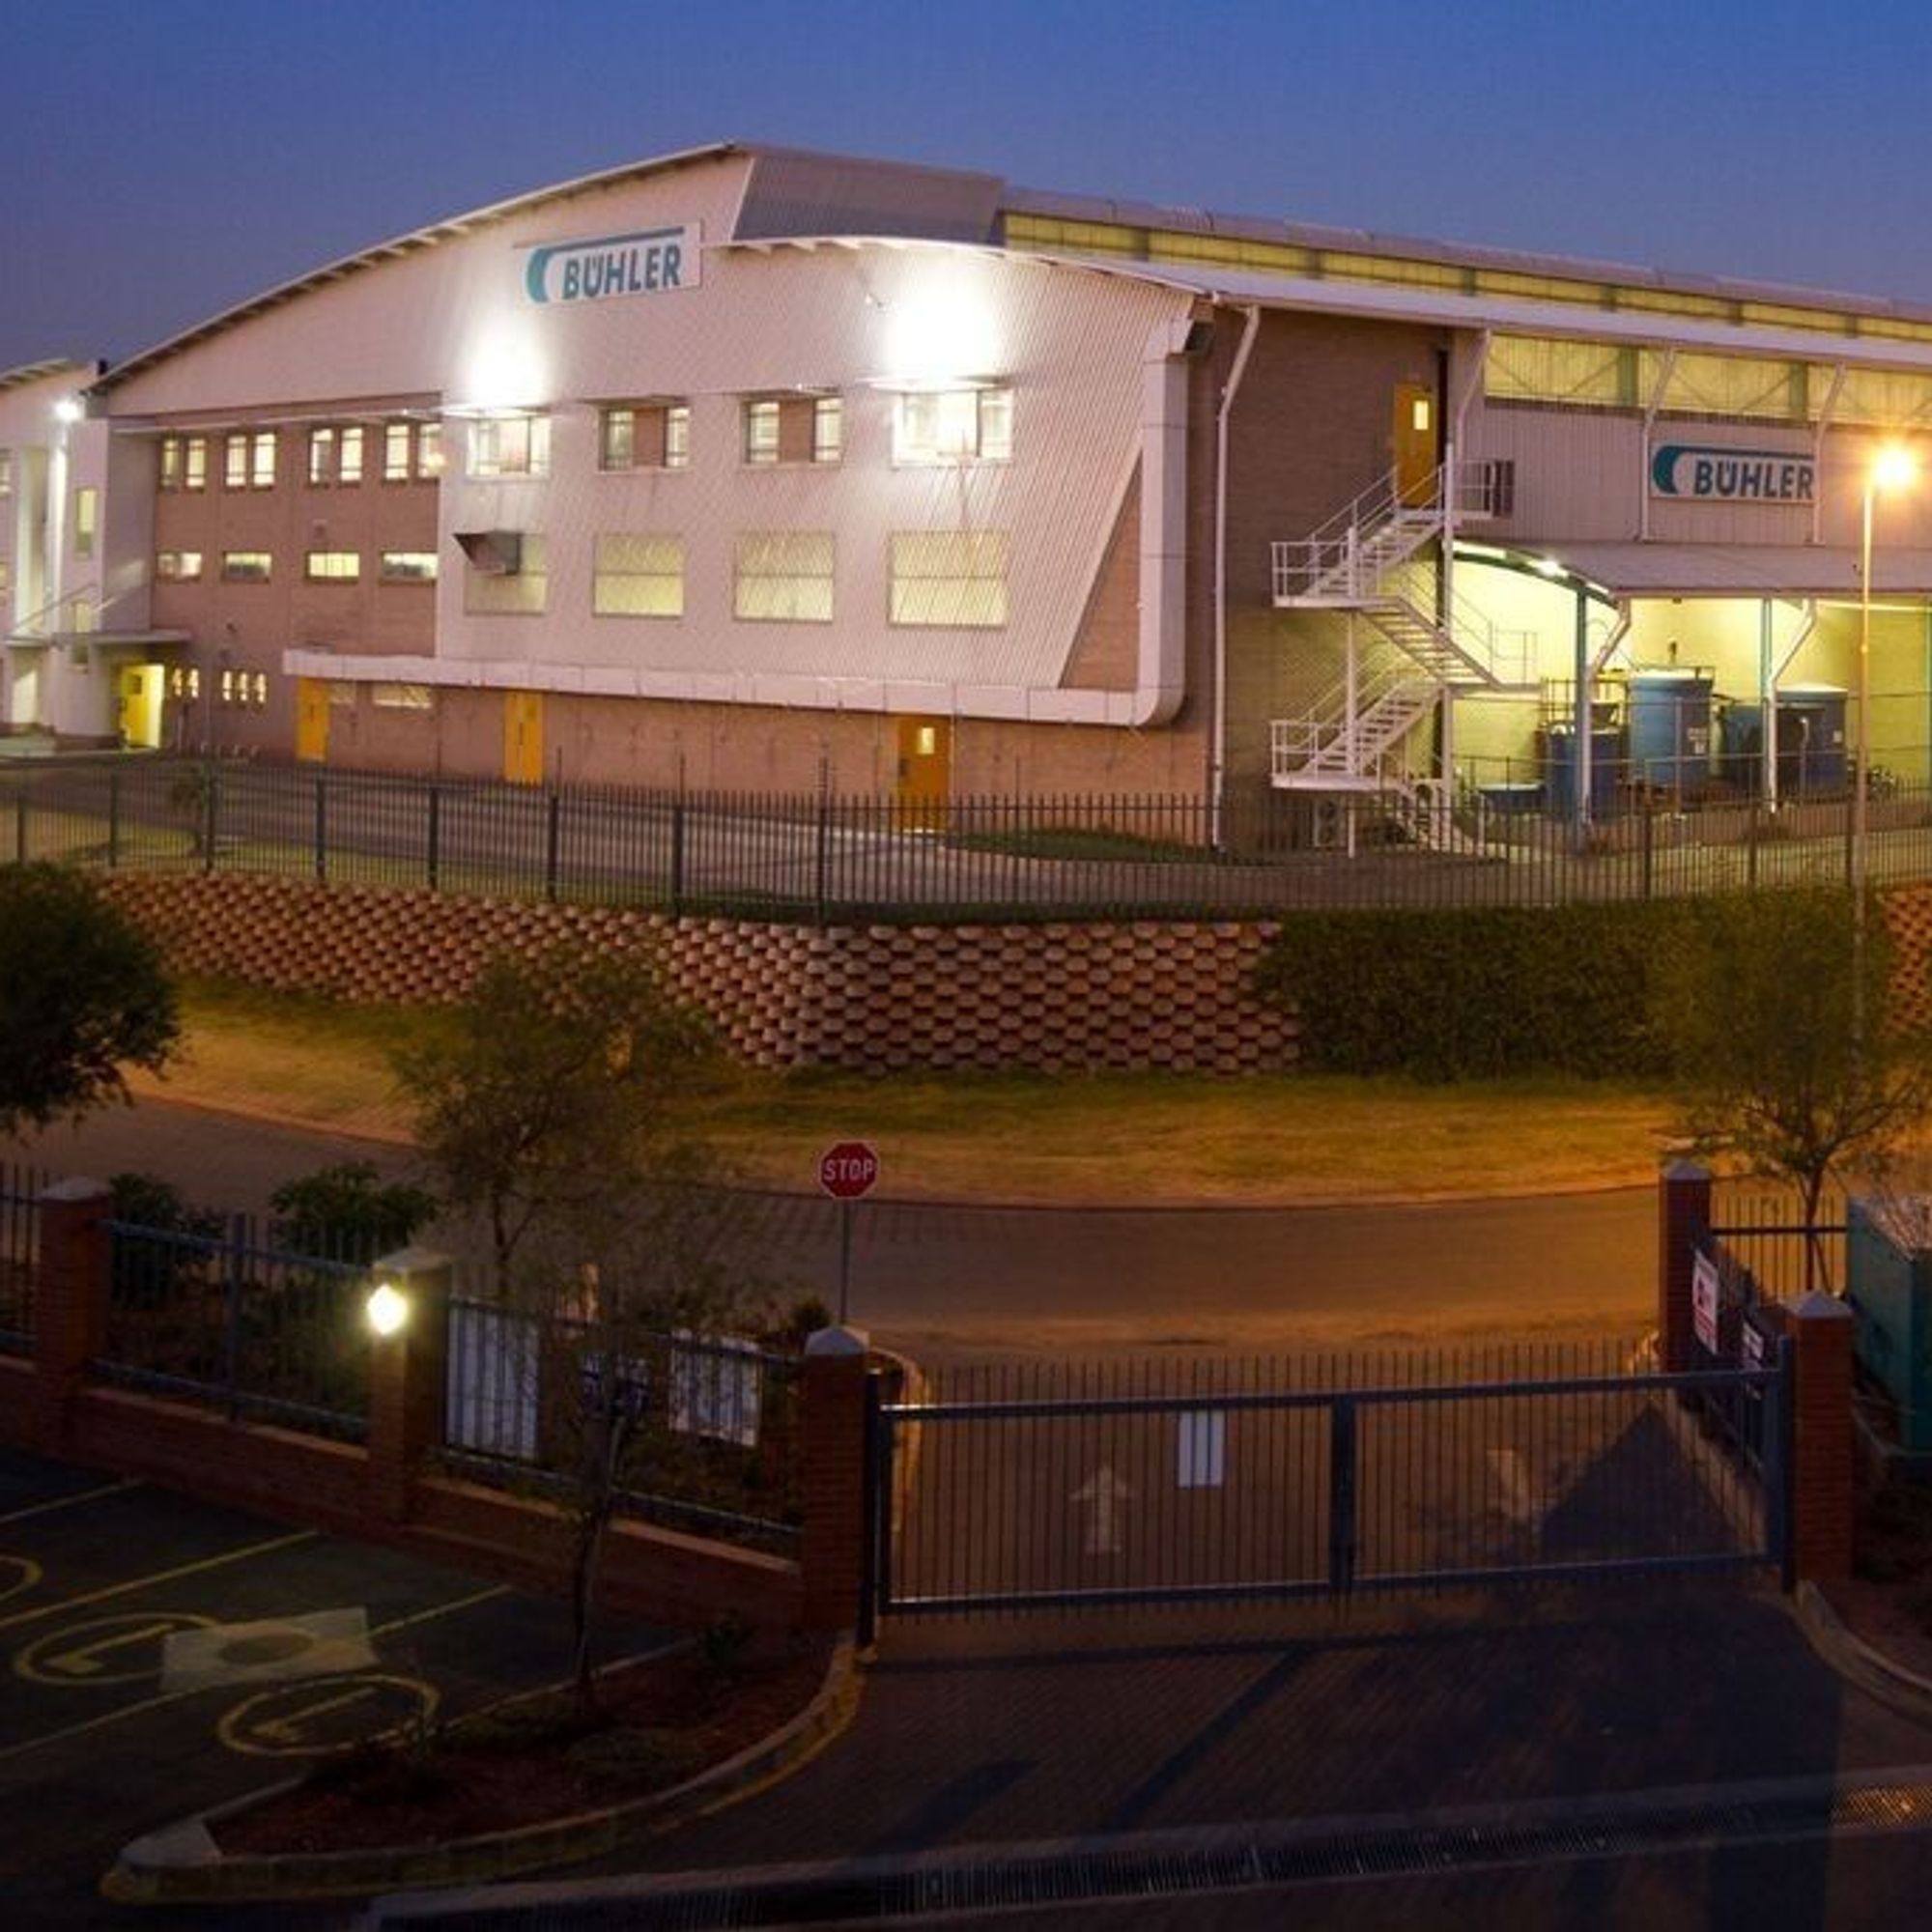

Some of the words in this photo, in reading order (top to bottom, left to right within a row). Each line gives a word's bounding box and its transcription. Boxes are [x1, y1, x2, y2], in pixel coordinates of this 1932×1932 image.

[562, 244, 681, 299] BÜHLER
[1693, 459, 1814, 499] BÜHLER
[823, 1158, 873, 1180] STOP
